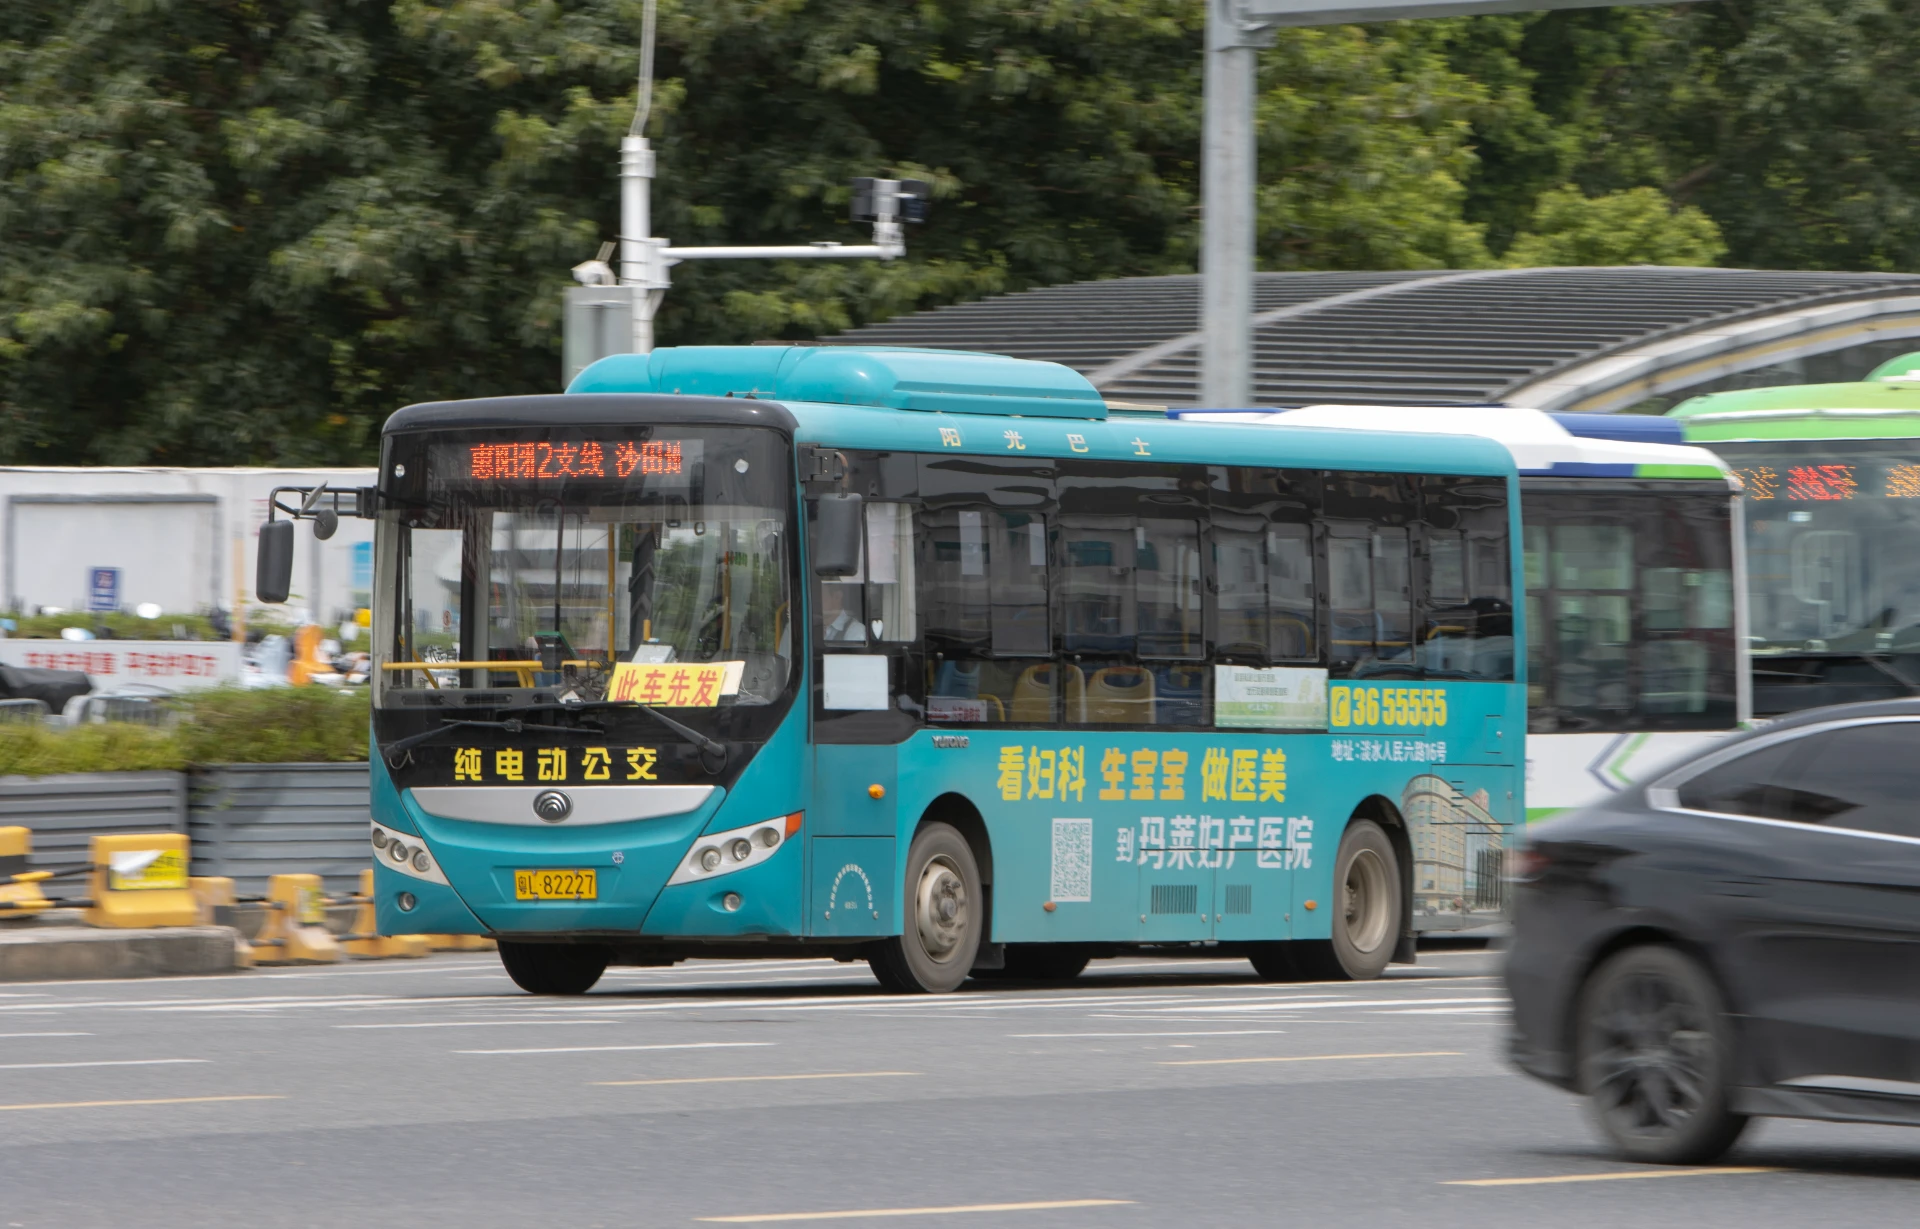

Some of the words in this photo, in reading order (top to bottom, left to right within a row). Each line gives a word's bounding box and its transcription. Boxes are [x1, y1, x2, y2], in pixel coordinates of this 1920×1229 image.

[938, 427, 1152, 456] 阳光巴士
[614, 668, 719, 707] 此车先发
[931, 735, 970, 749] YUTONG
[454, 747, 658, 781] 纯电动公交
[997, 745, 1086, 802] 看妇科
[1098, 747, 1188, 801] 生宝宝
[1201, 747, 1287, 803] 做医美
[1115, 815, 1314, 870] 到玛莱妇产医院
